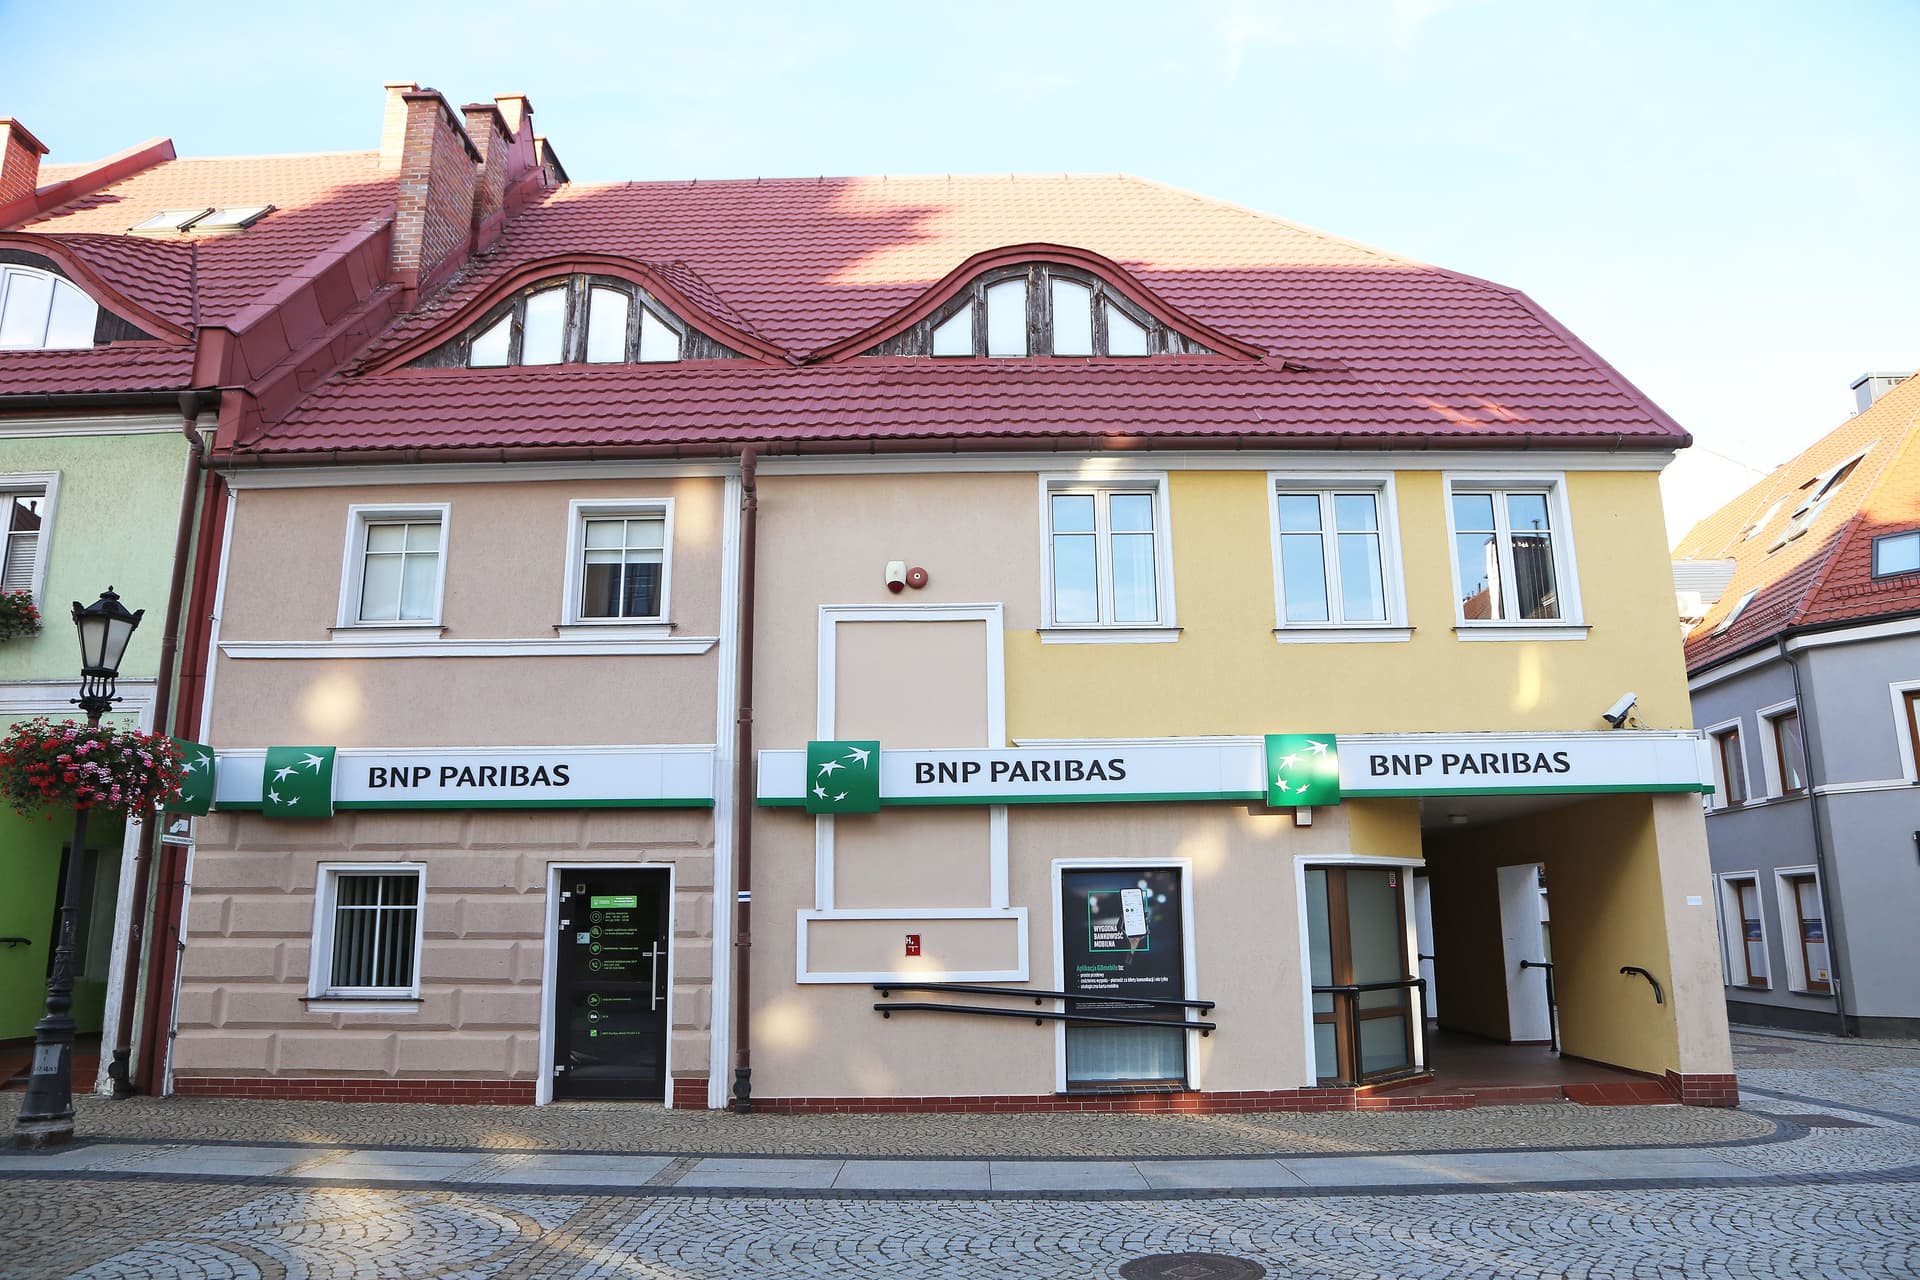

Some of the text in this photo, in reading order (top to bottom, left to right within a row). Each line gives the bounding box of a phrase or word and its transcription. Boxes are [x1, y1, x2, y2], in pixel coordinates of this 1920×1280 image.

[368, 764, 570, 789] BNP PARIBAS
[915, 758, 1126, 784] BNP PARIBAS
[1369, 751, 1571, 777] BNP PARIBAS
[1093, 940, 1116, 948] MOBILNA
